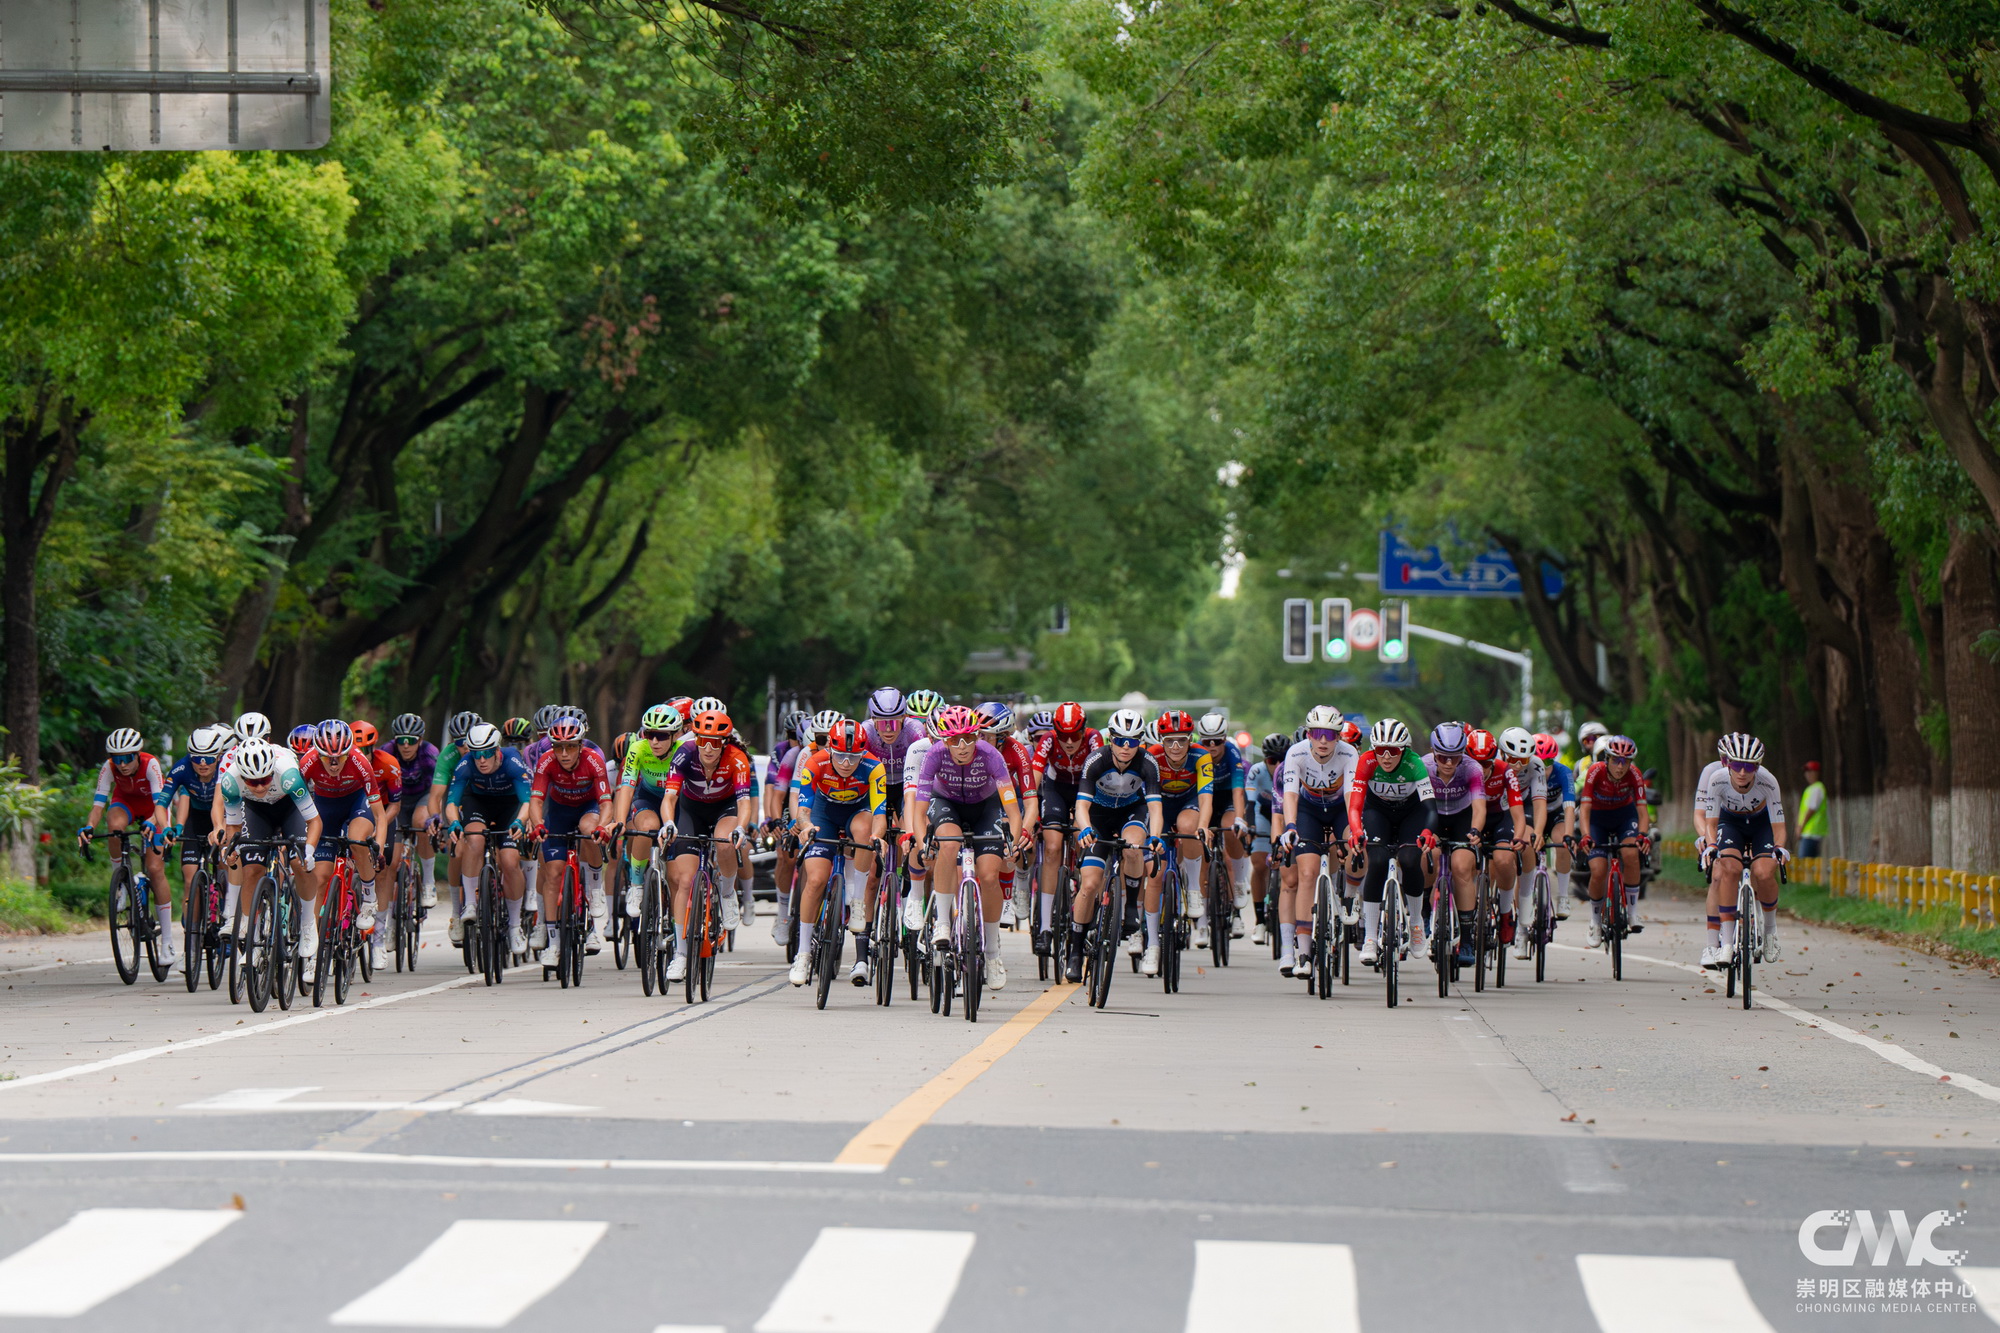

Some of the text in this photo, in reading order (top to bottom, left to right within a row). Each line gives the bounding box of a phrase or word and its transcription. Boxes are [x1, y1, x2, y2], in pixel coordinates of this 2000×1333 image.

[1012, 743, 1029, 767] Roland
[171, 764, 186, 775] coop
[300, 758, 314, 775] land
[352, 755, 369, 777] Roland
[537, 756, 553, 775] Roland
[586, 755, 603, 773] Roland
[1305, 776, 1337, 789] UAE
[1373, 782, 1408, 796] UAE
[245, 852, 265, 862] Liv
